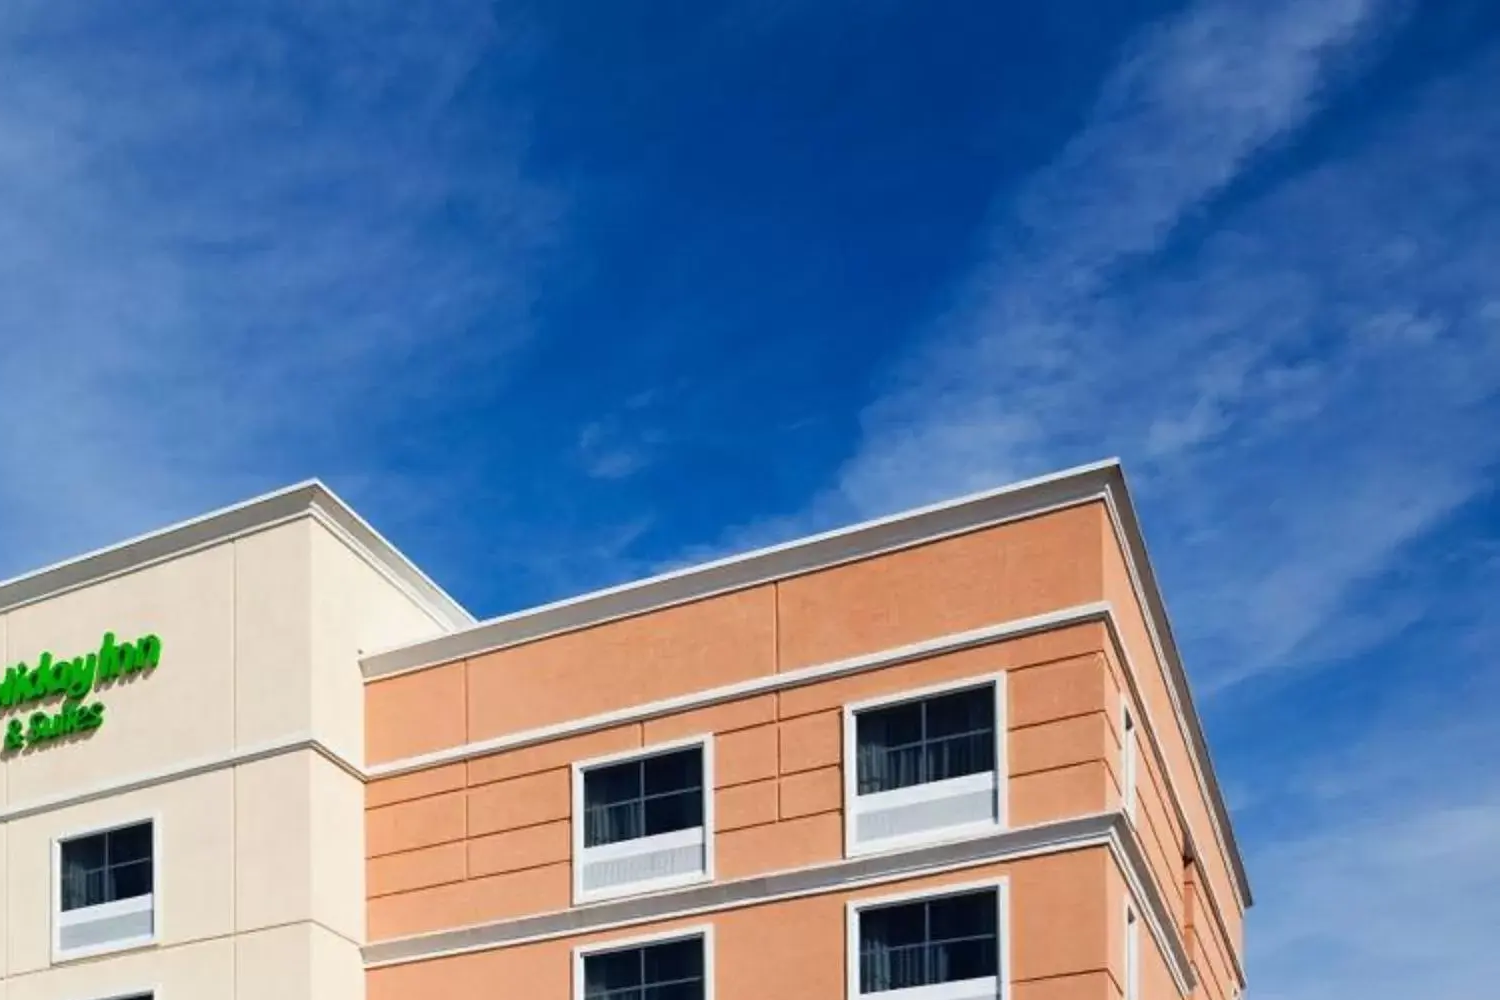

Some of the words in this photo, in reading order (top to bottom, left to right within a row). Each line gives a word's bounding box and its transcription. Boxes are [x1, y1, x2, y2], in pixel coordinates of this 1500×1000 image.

[99, 632, 161, 684] Inn
[5, 718, 25, 750] &
[27, 702, 105, 744] Suites
